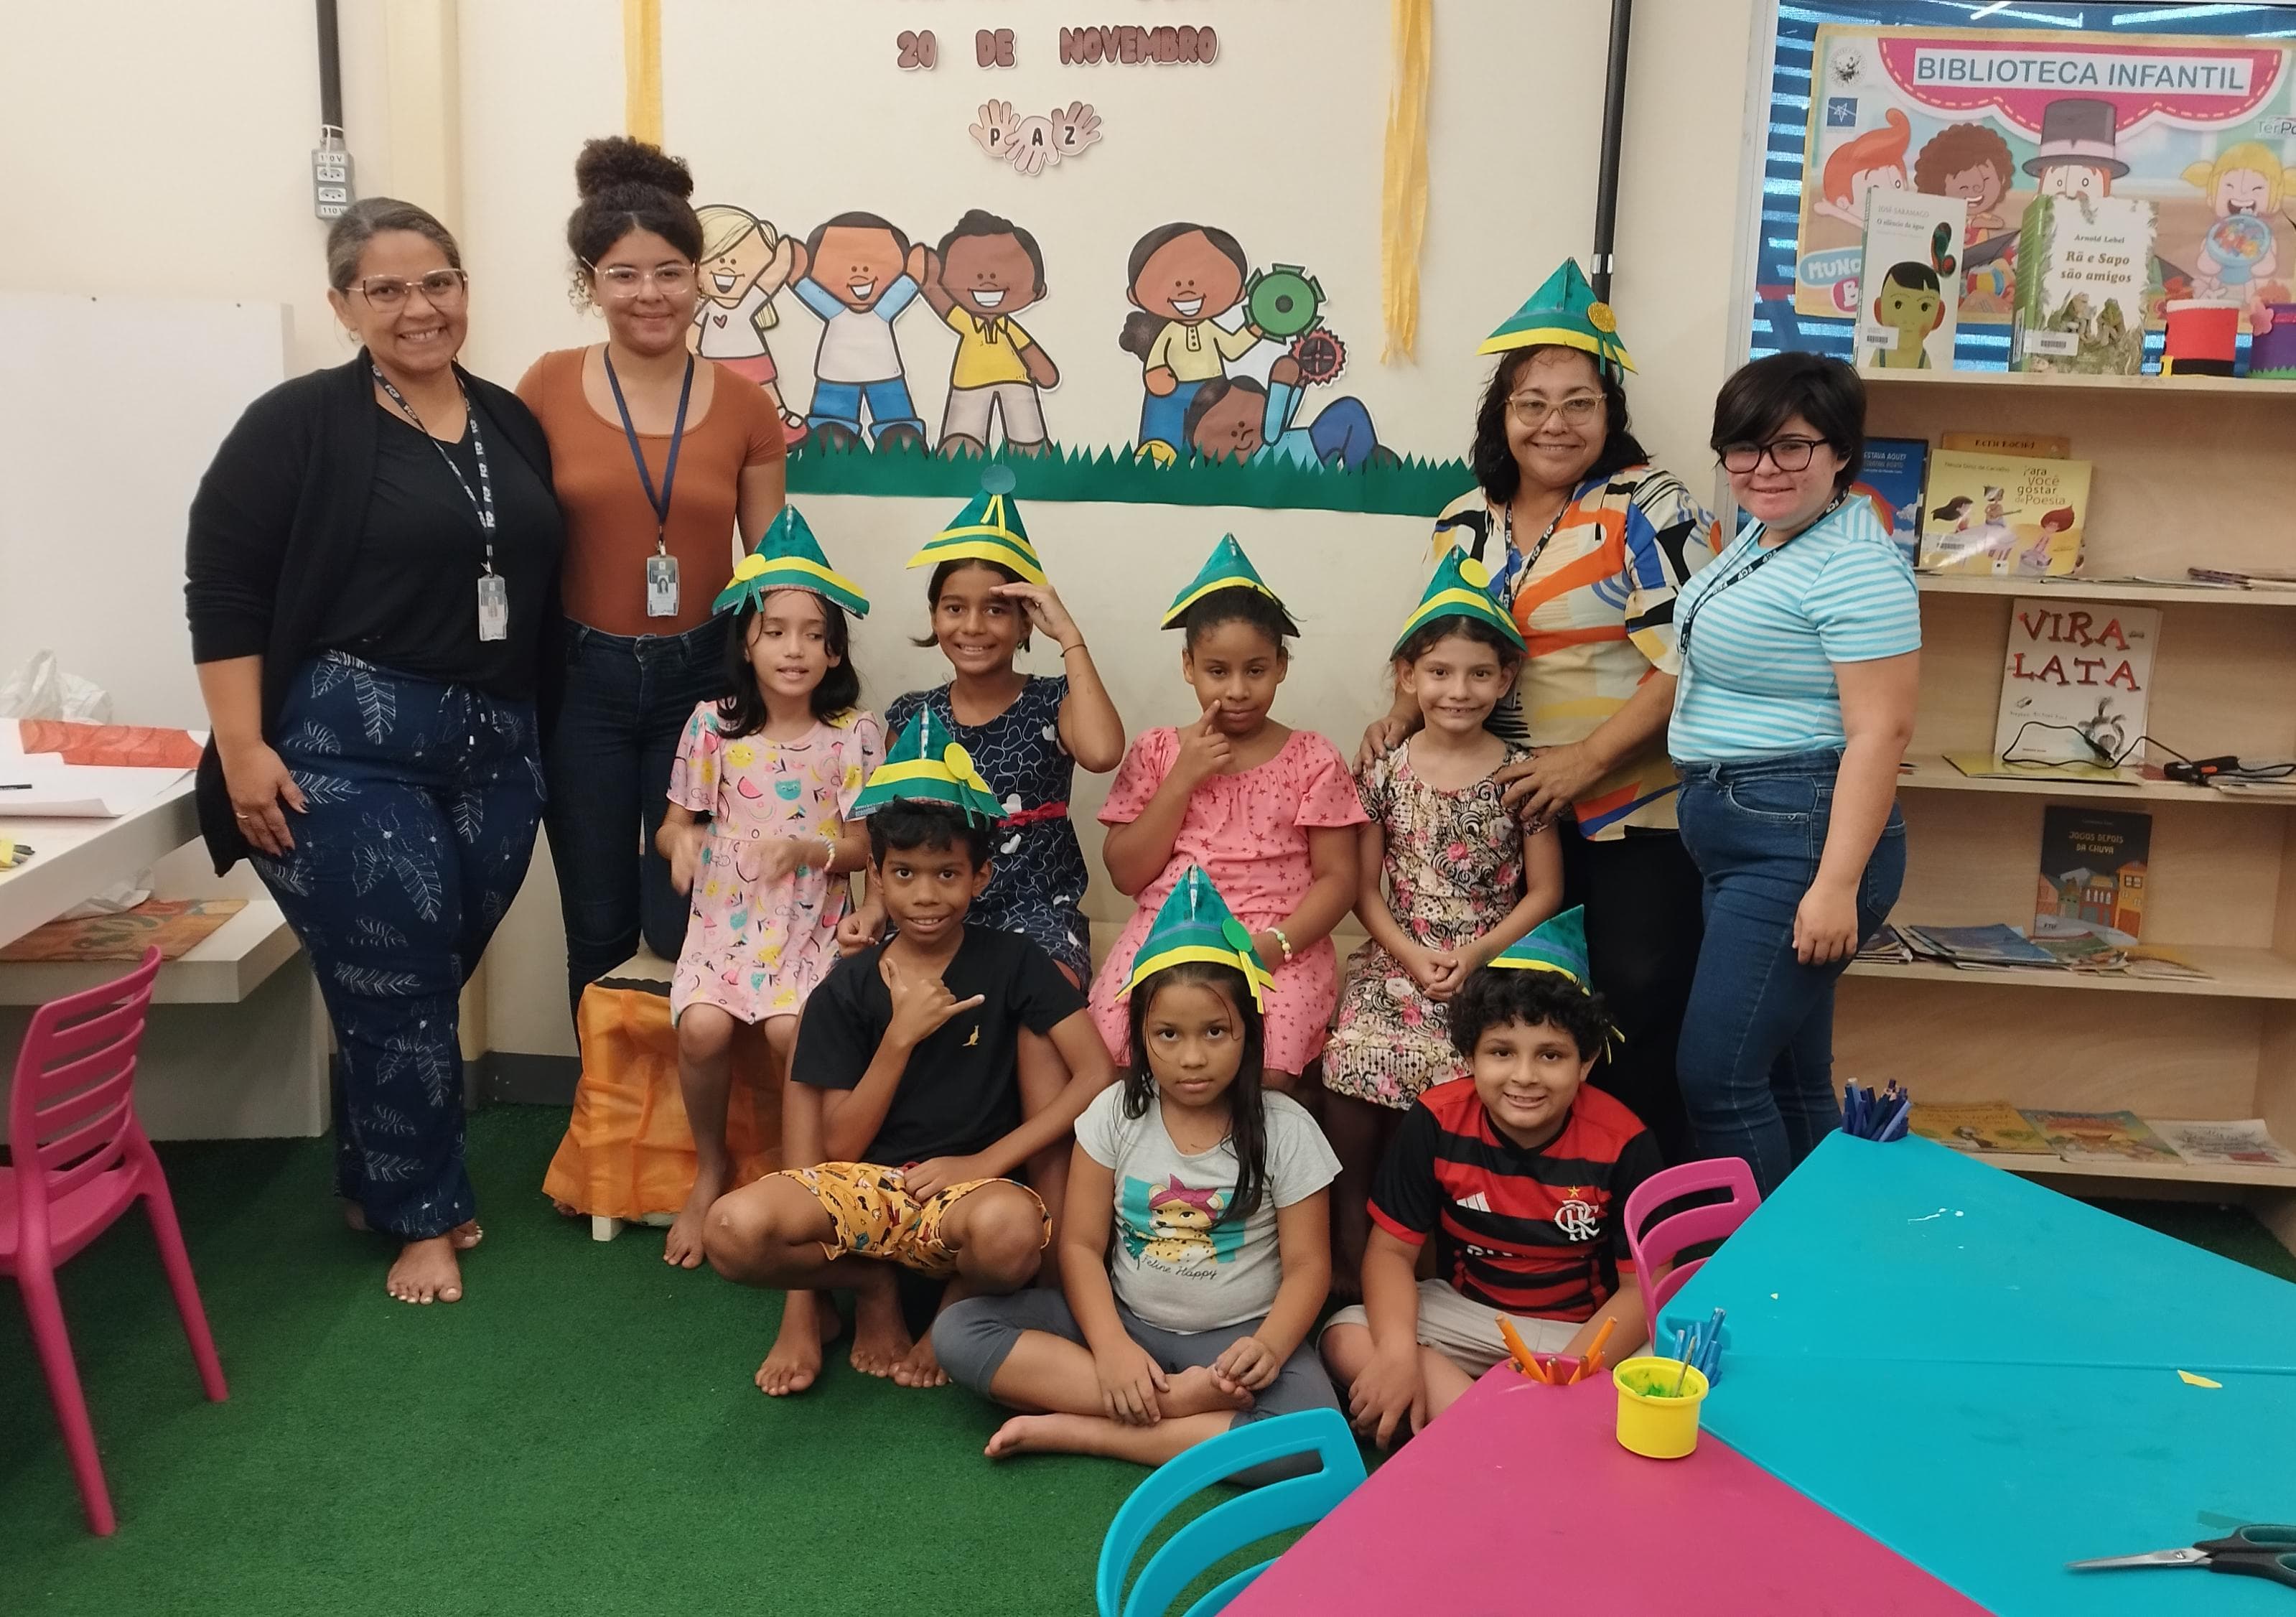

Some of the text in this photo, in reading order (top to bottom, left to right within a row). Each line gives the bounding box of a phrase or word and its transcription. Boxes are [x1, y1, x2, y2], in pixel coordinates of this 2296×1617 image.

[897, 26, 1217, 67] 20 DE NOVEMBRO
[1918, 57, 2244, 90] BIBLIOTECA INFANTIL
[2066, 251, 2083, 262] Rã
[2098, 253, 2130, 267] Sapo
[2060, 268, 2132, 284] são amigos
[2023, 465, 2047, 477] Para
[2017, 485, 2057, 496] gostar
[2025, 495, 2066, 505] Poesia
[2097, 834, 2124, 844] DEPOIS
[2089, 844, 2114, 855] CHUVA
[1142, 1254, 1217, 1280] Feline Happy
